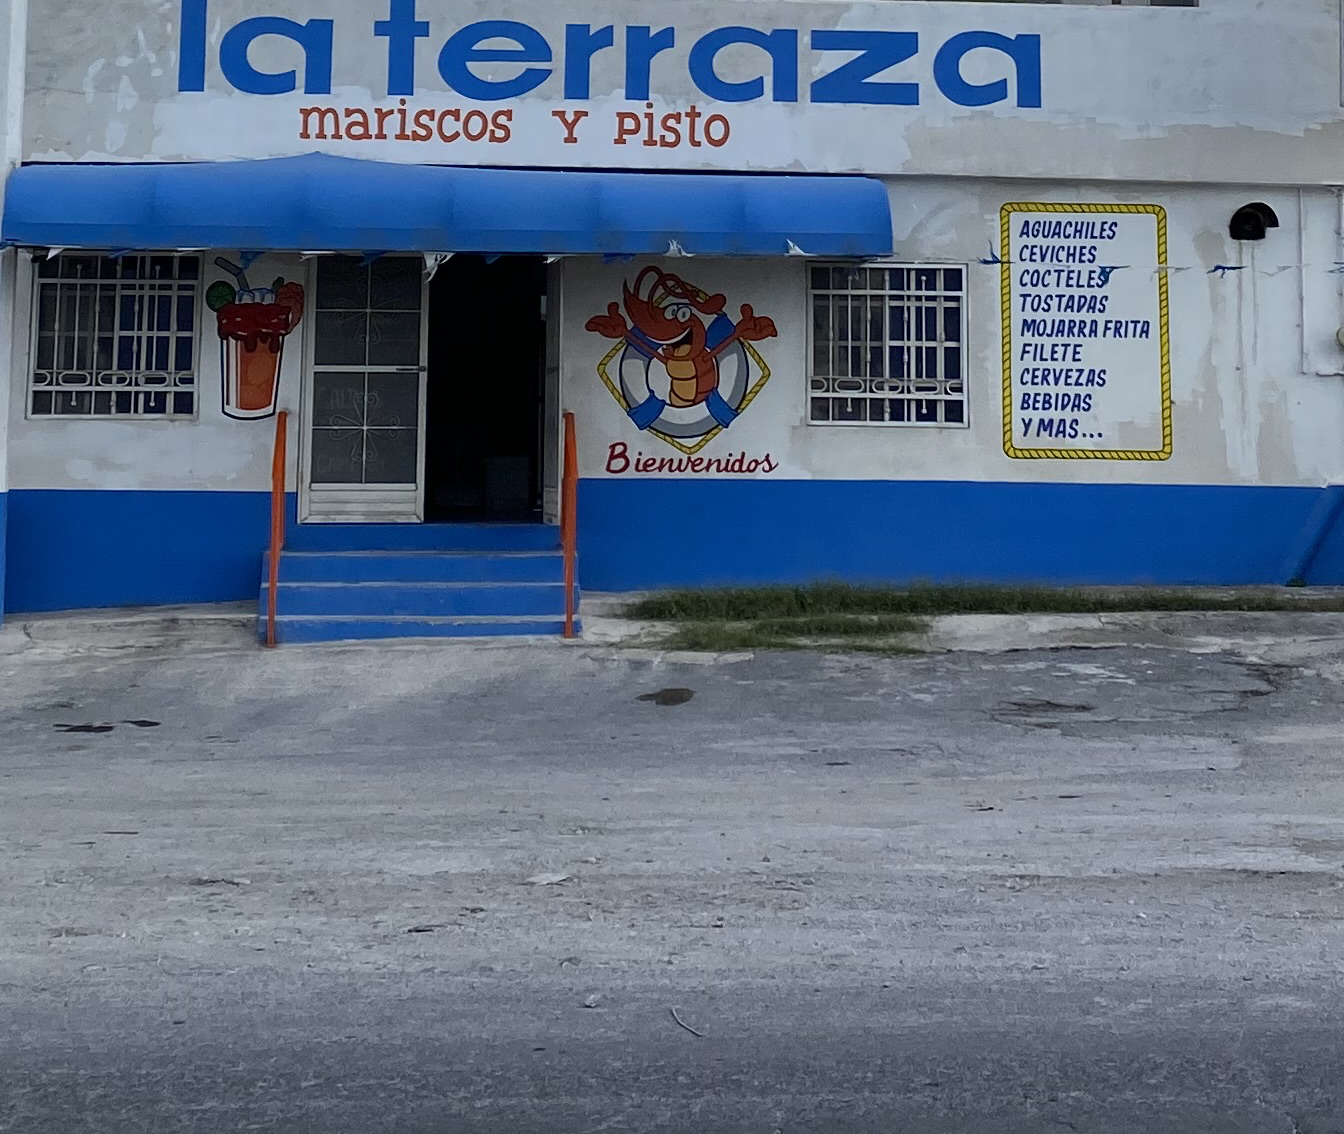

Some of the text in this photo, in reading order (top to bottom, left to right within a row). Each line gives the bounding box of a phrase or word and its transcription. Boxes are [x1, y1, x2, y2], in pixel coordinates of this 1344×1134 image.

[299, 98, 513, 143] mariscos
[1019, 220, 1118, 240] AGUACHILES
[1019, 245, 1097, 264] CEVICHES
[1019, 269, 1105, 288] COCTELES
[1019, 294, 1109, 313] TOSTADAS
[1020, 319, 1150, 339] MOJARRA FRITA
[1020, 343, 1083, 363] FILETE
[1020, 368, 1106, 387] CERVEZAS
[1020, 393, 1092, 412] BEBIDAS
[1021, 418, 1033, 438] Y
[605, 441, 779, 474] Bienvenidos
